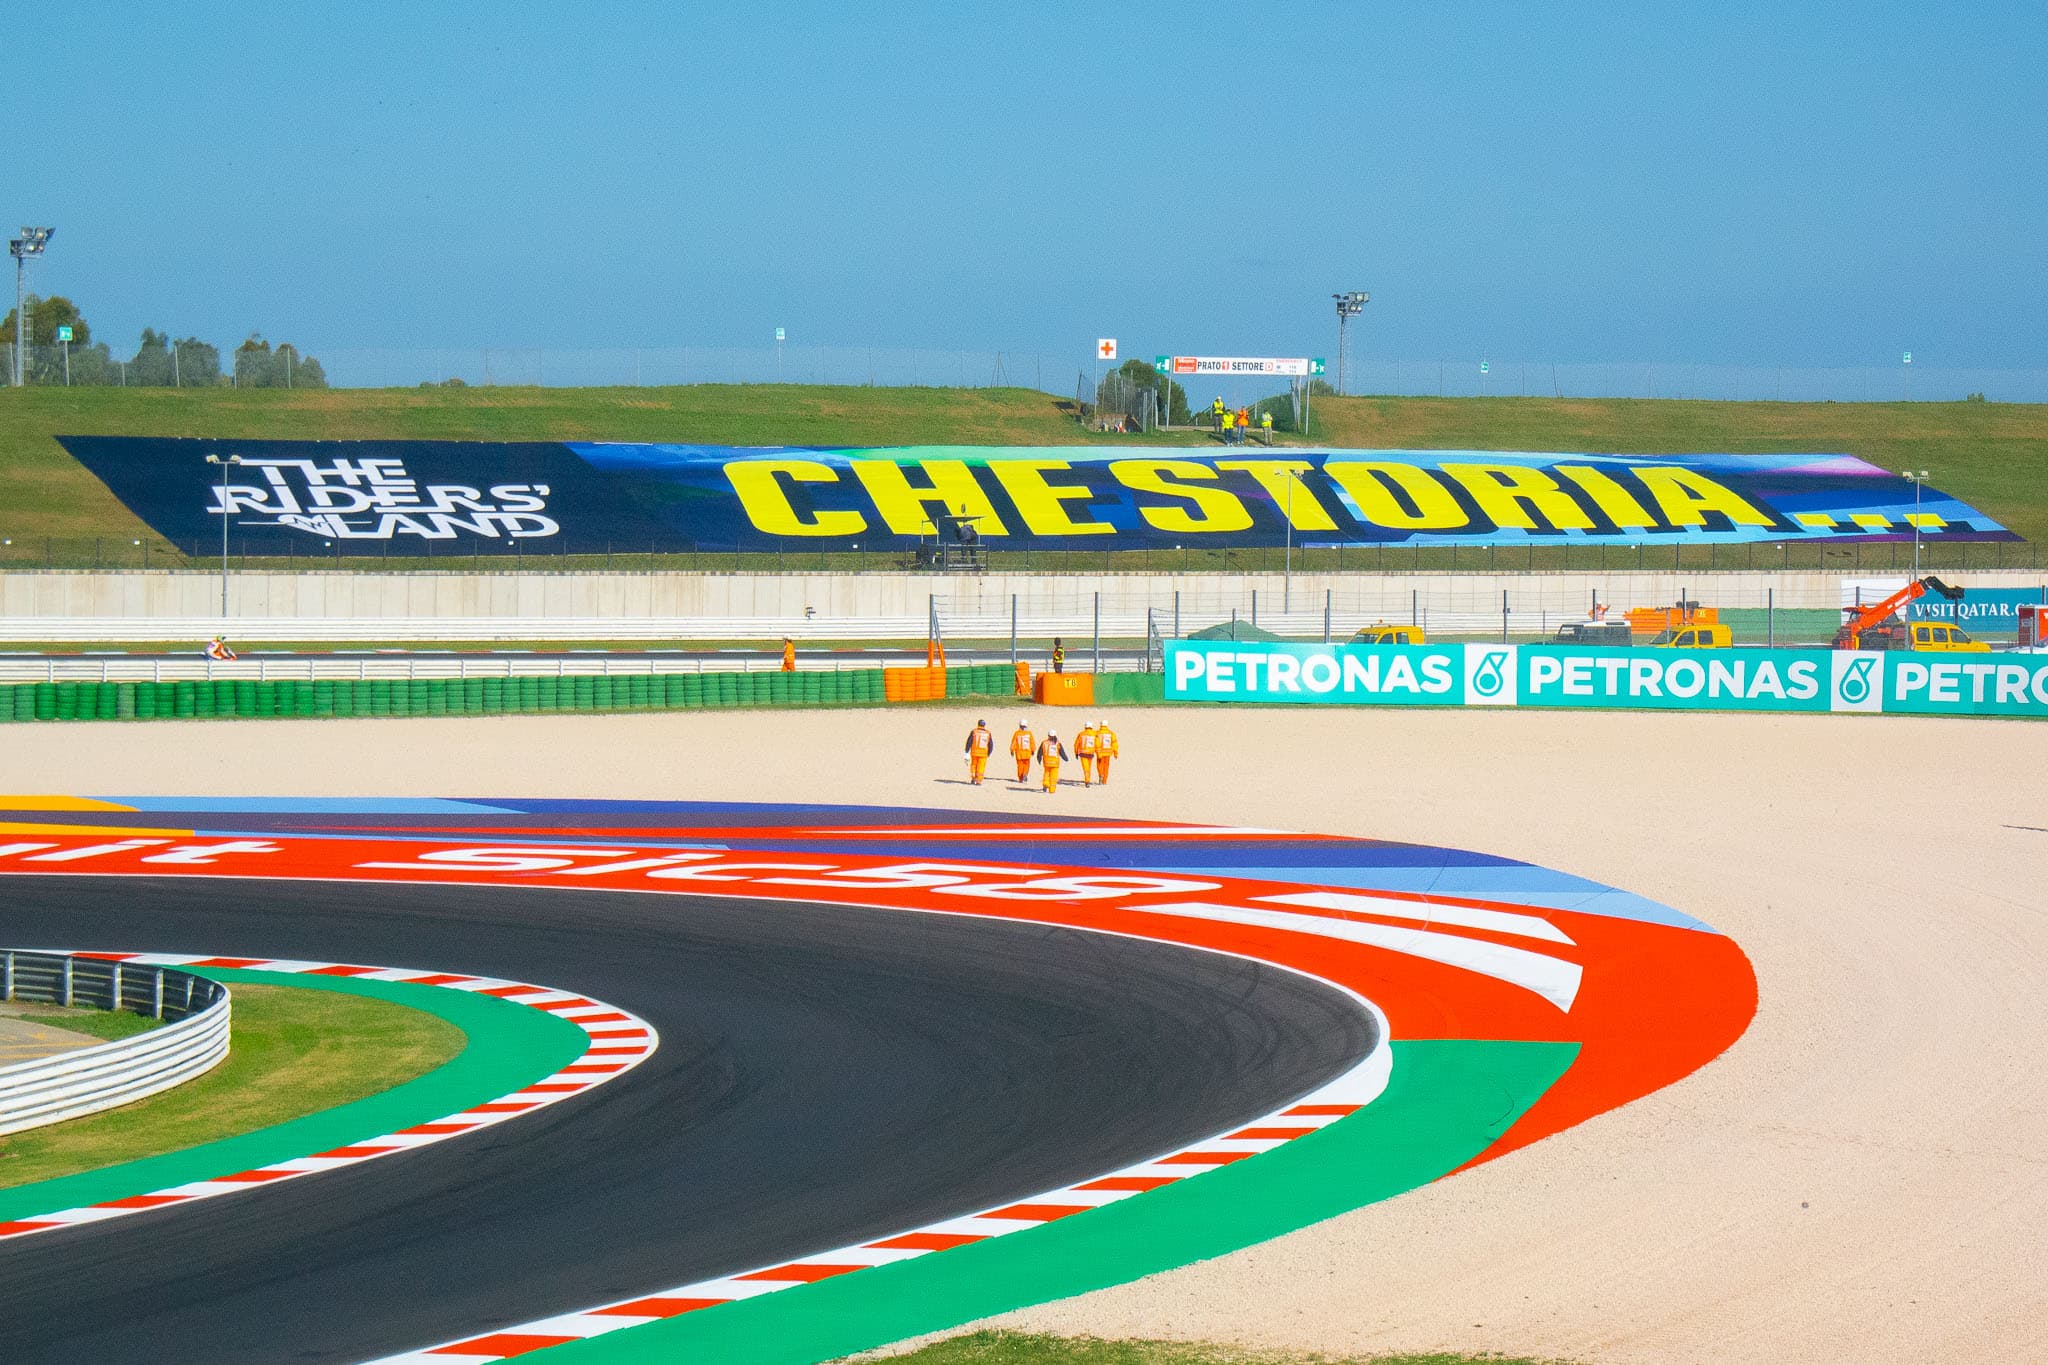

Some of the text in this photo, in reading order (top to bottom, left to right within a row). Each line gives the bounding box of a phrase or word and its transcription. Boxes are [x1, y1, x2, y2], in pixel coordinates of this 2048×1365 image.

[1197, 361, 1221, 370] PRATO
[1232, 362, 1264, 371] SETTORE
[240, 459, 416, 485] THE
[323, 513, 560, 538] LAND
[1174, 651, 1453, 695] PETRONAS
[1528, 656, 1819, 699] PETRONAS
